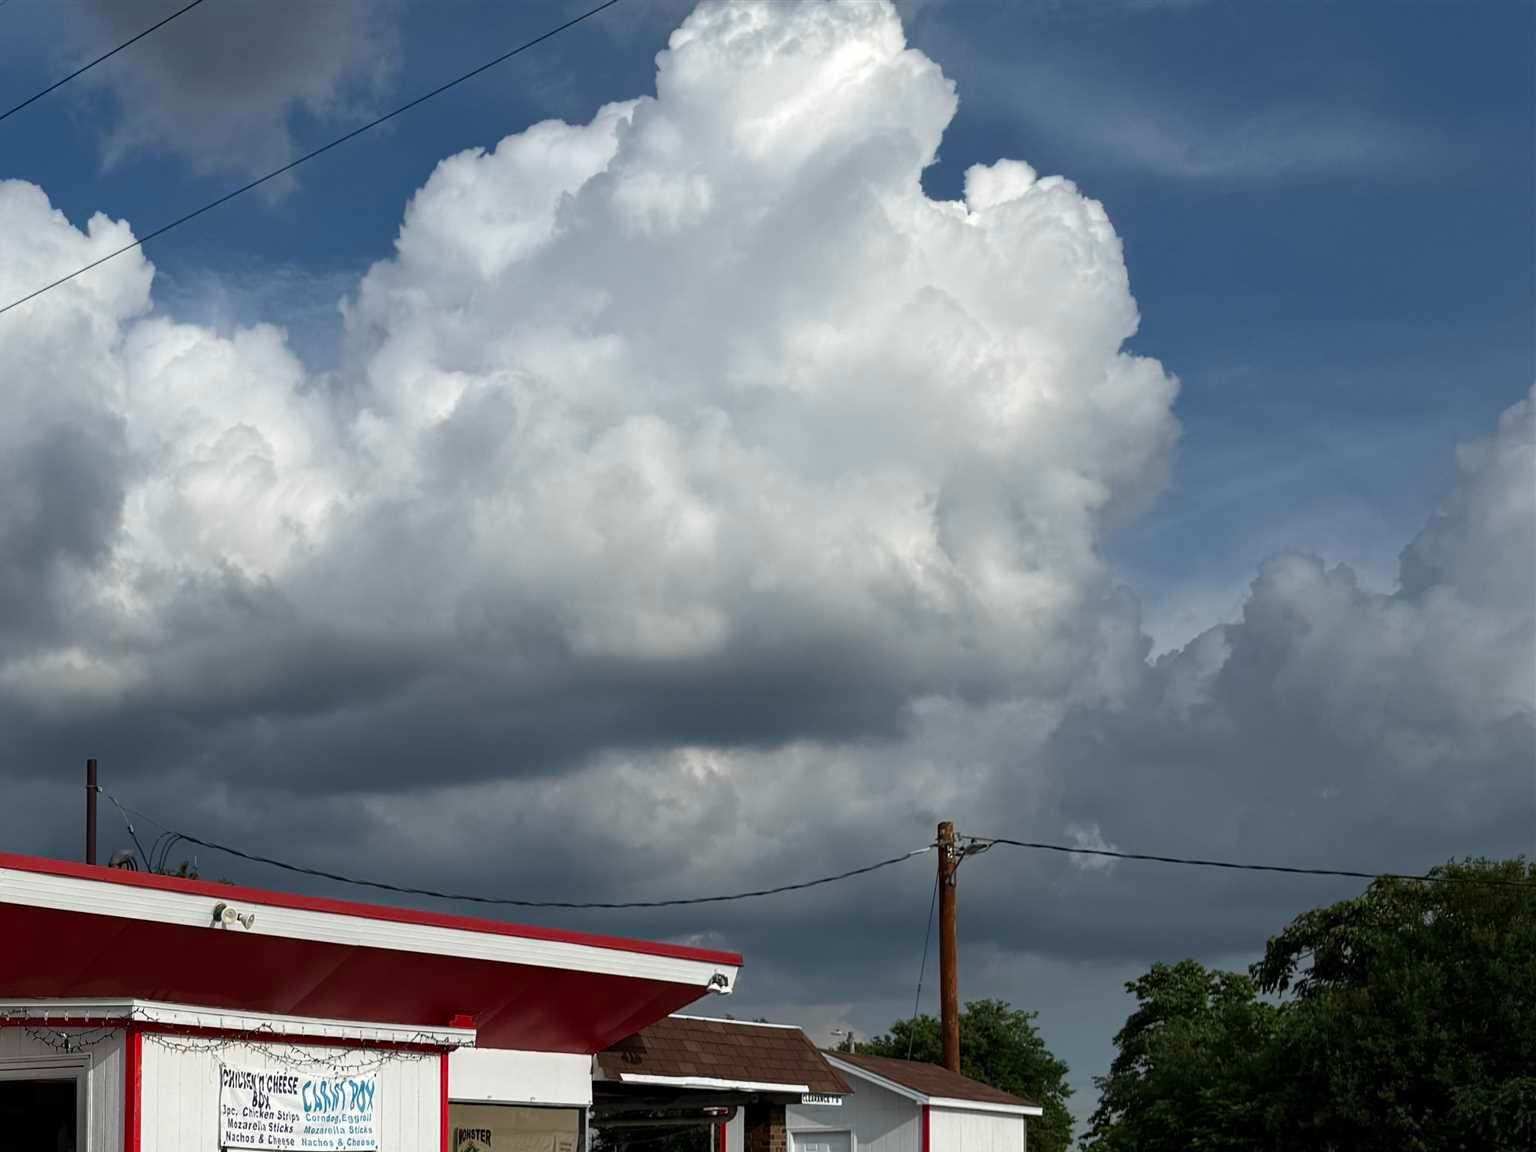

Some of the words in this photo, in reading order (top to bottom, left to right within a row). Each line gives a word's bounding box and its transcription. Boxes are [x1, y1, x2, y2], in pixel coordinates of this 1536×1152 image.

[221, 1068, 256, 1091] CHICKEN
[267, 1075, 298, 1095] CHEESE
[252, 1090, 271, 1110] BOX
[348, 1079, 375, 1113] BOX
[242, 1107, 275, 1119] Chicken
[277, 1110, 300, 1123] Strips
[268, 1122, 294, 1133] Sticks
[348, 1126, 373, 1135] Sticks
[225, 1131, 255, 1144] Nachos
[258, 1134, 264, 1144] &
[268, 1134, 295, 1146] Cheese
[301, 1137, 334, 1147] Nachos
[337, 1138, 344, 1147] &
[346, 1138, 375, 1147] Cheese
[457, 1127, 491, 1147] MONSTER
